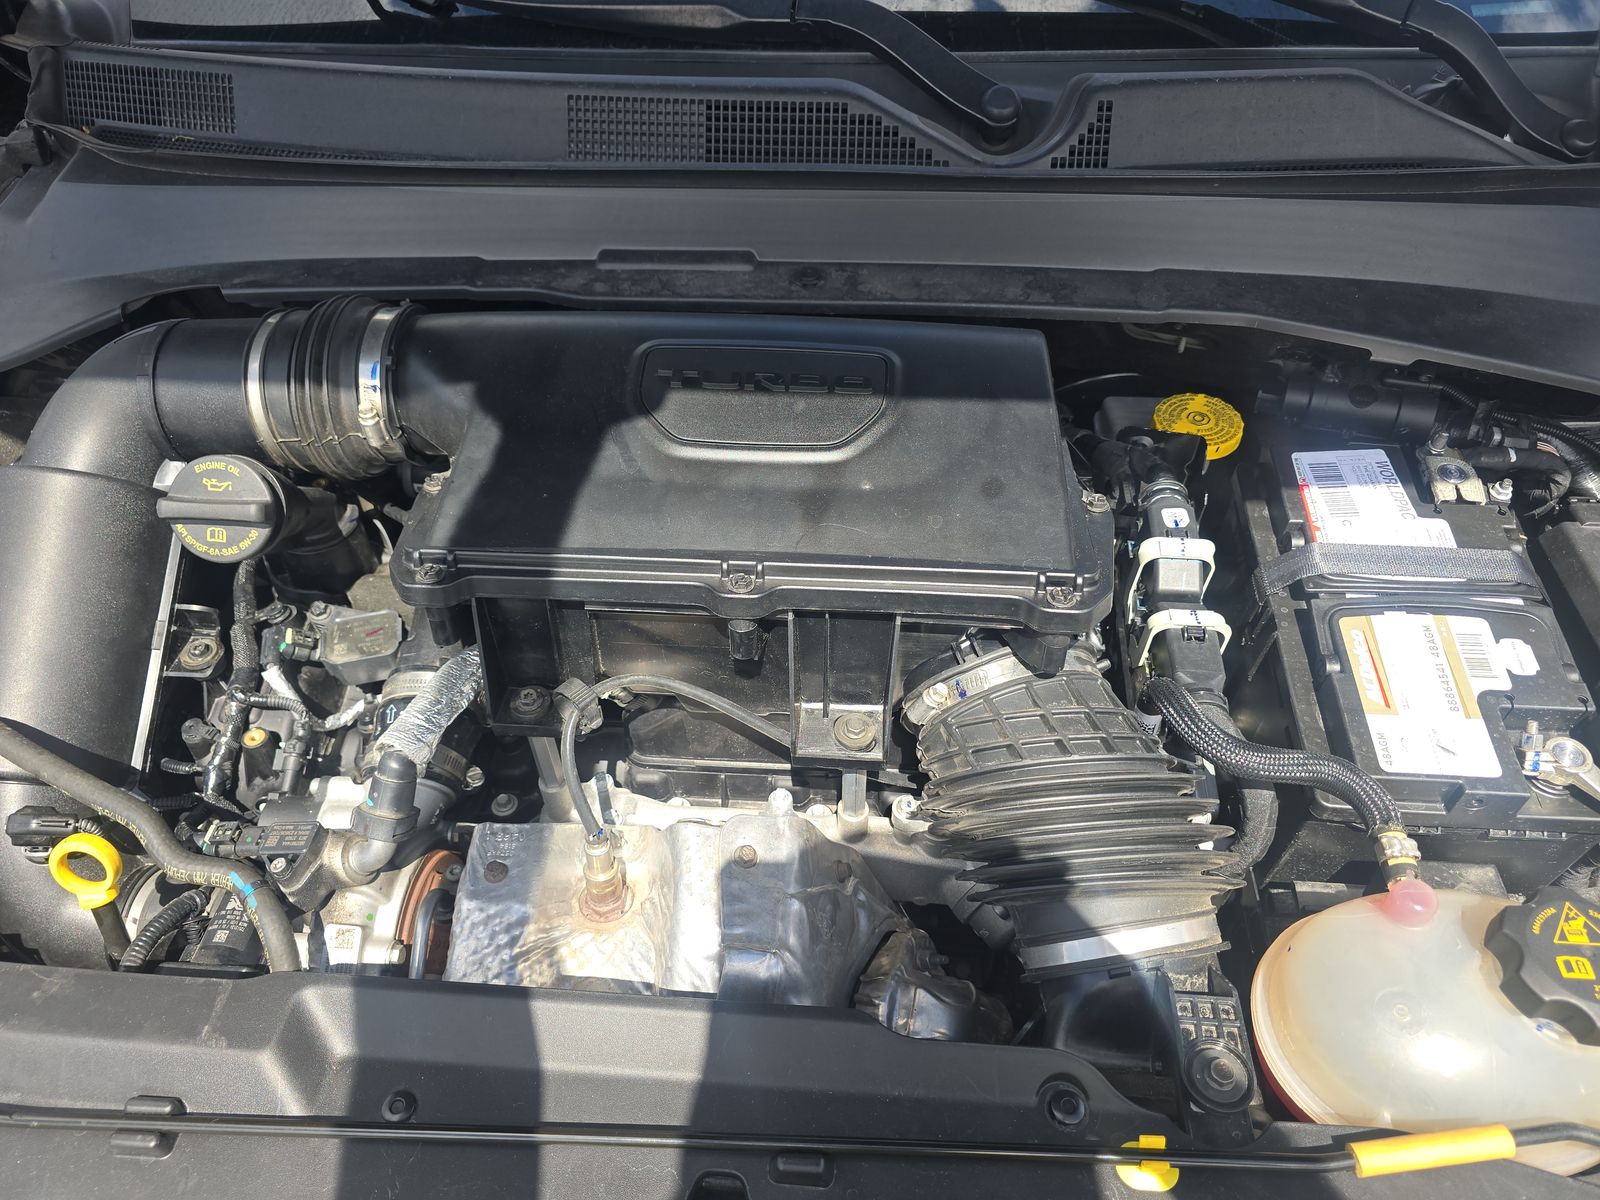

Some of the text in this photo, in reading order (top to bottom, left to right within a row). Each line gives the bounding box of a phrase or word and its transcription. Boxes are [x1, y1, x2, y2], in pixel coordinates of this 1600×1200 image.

[194, 462, 241, 477] ENGINE OIL
[1375, 460, 1416, 520] WORLDPAC
[1421, 624, 1441, 658] 48AGM
[1435, 662, 1460, 712] 88864541
[1376, 732, 1393, 766] 48AGM
